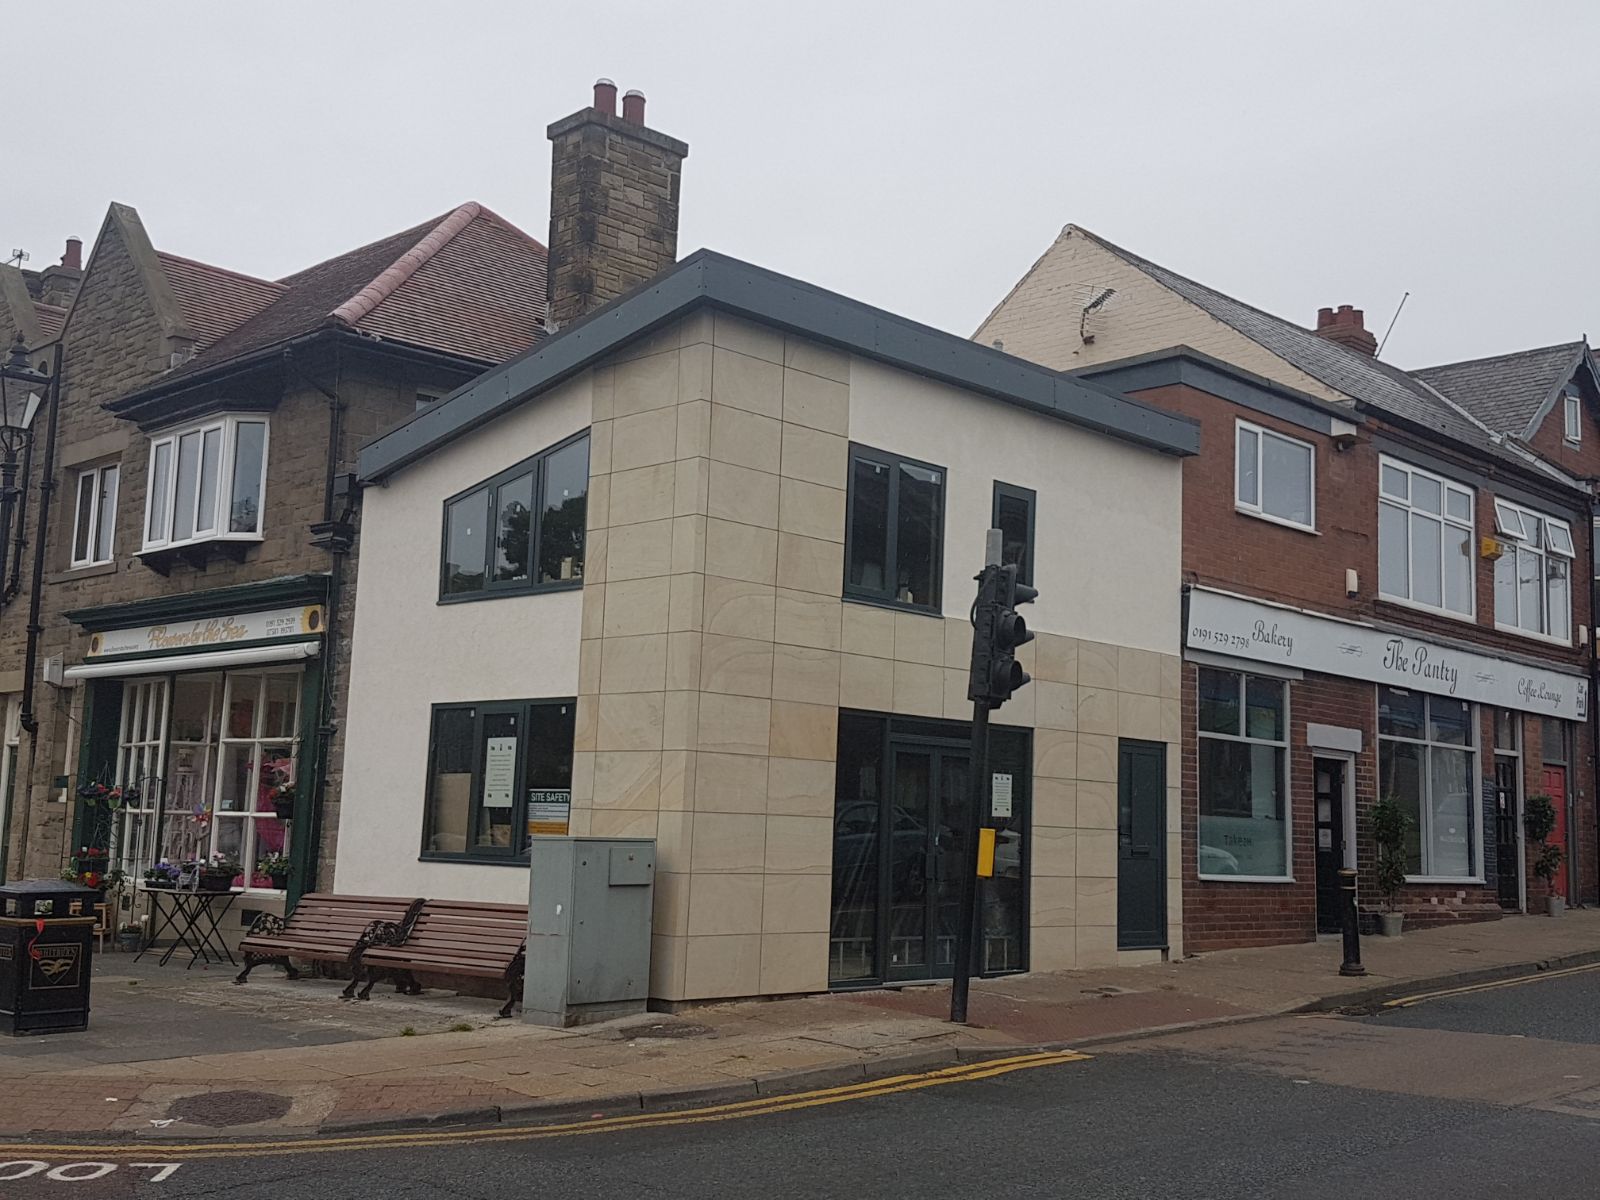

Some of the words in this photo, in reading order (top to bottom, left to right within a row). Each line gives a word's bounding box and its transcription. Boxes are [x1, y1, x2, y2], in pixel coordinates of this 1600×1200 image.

[148, 626, 190, 649] Flowers
[190, 622, 203, 645] by
[202, 619, 220, 642] the
[219, 616, 248, 642] Sea
[1192, 627, 1212, 642] 0191
[1214, 632, 1229, 646] 529
[1231, 635, 1250, 651] 2798
[1252, 619, 1293, 657] Bakery
[1383, 638, 1409, 673] The
[1412, 646, 1458, 694] Pantry
[1517, 677, 1537, 703] Coffee
[1537, 682, 1562, 709] Lounge
[531, 792, 545, 802] SITE
[546, 792, 570, 802] SAFETY
